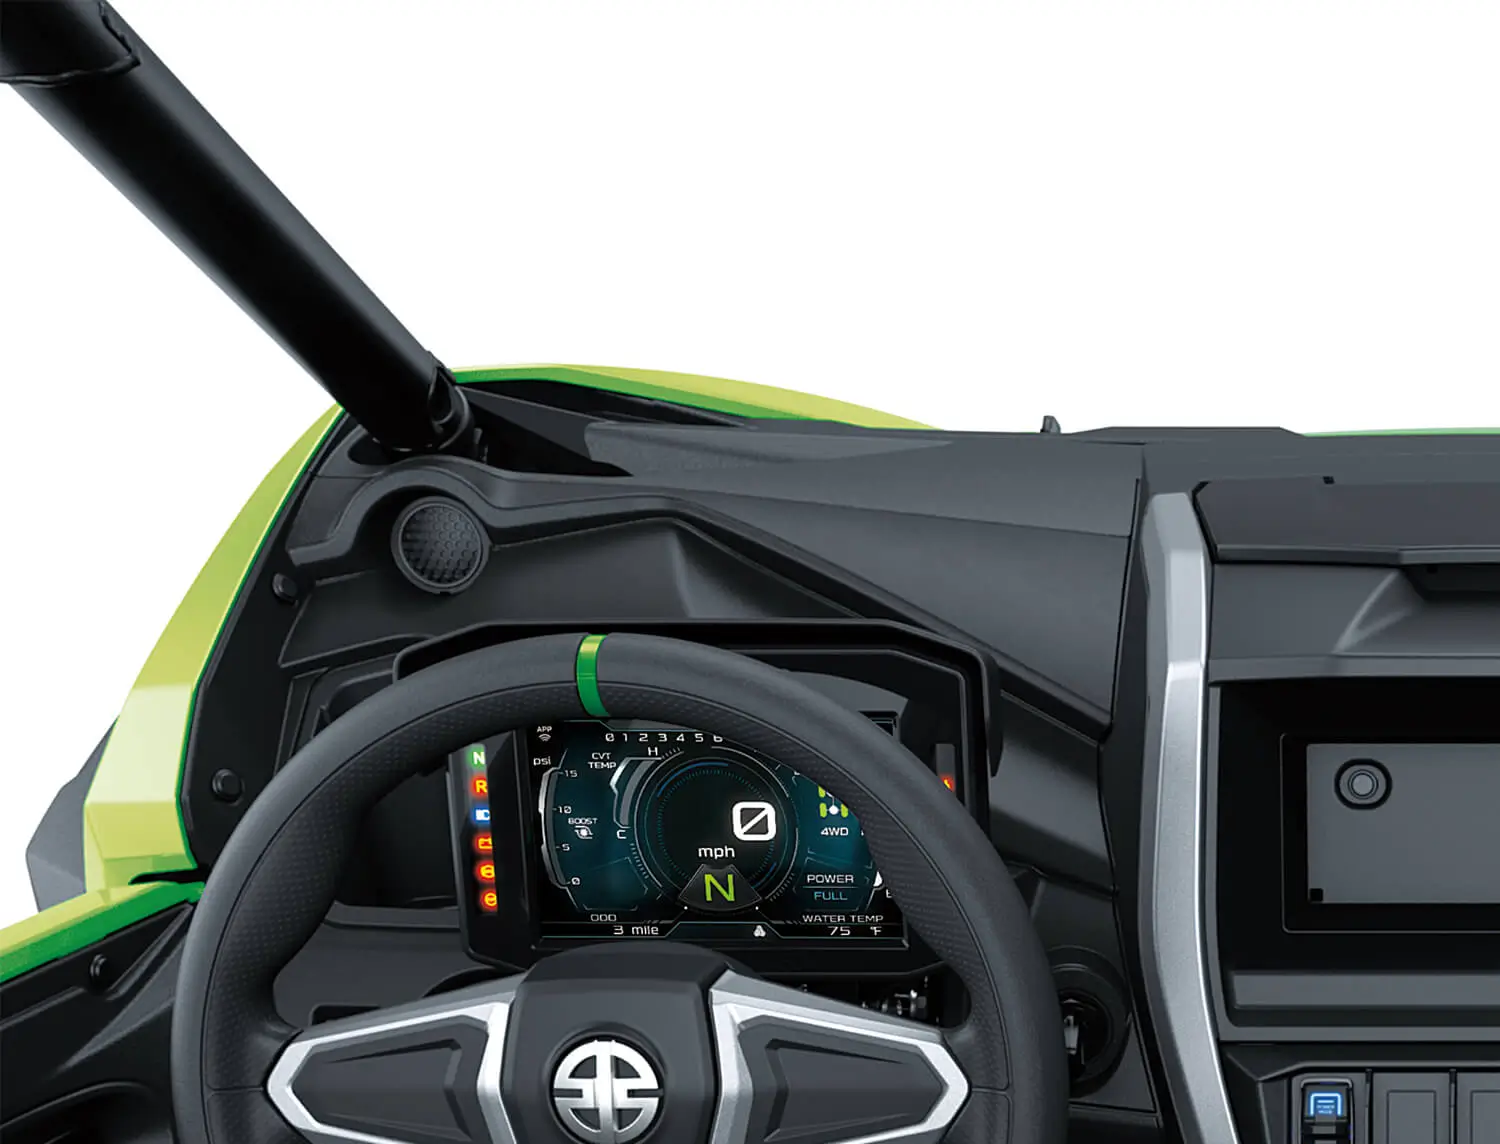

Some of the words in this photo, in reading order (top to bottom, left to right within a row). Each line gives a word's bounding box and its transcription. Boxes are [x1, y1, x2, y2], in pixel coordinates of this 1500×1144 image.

[536, 725, 553, 733] APP
[605, 733, 615, 742] 0
[622, 733, 628, 742] 1
[638, 733, 649, 742] 2
[657, 733, 668, 742] 3
[676, 733, 685, 742] 4
[694, 733, 704, 743] 5
[591, 752, 611, 760] CVT
[647, 746, 658, 756] H
[472, 751, 486, 765] N
[533, 757, 551, 766] psi
[587, 761, 617, 770] TEMP
[564, 769, 578, 778] 15
[475, 779, 488, 793] R
[559, 805, 572, 814] 10
[567, 817, 597, 825] BOOST
[732, 801, 777, 841] 0
[616, 829, 627, 840] C
[820, 826, 849, 836] 4WD
[562, 843, 570, 851] 5
[698, 845, 735, 860] mph
[807, 874, 854, 884] POWER
[704, 873, 735, 902] N
[814, 891, 848, 901] FULL
[802, 914, 846, 923] WATER
[851, 914, 884, 923] TEMP
[613, 925, 624, 935] 3
[631, 925, 659, 935] mile
[830, 926, 851, 936] 75
